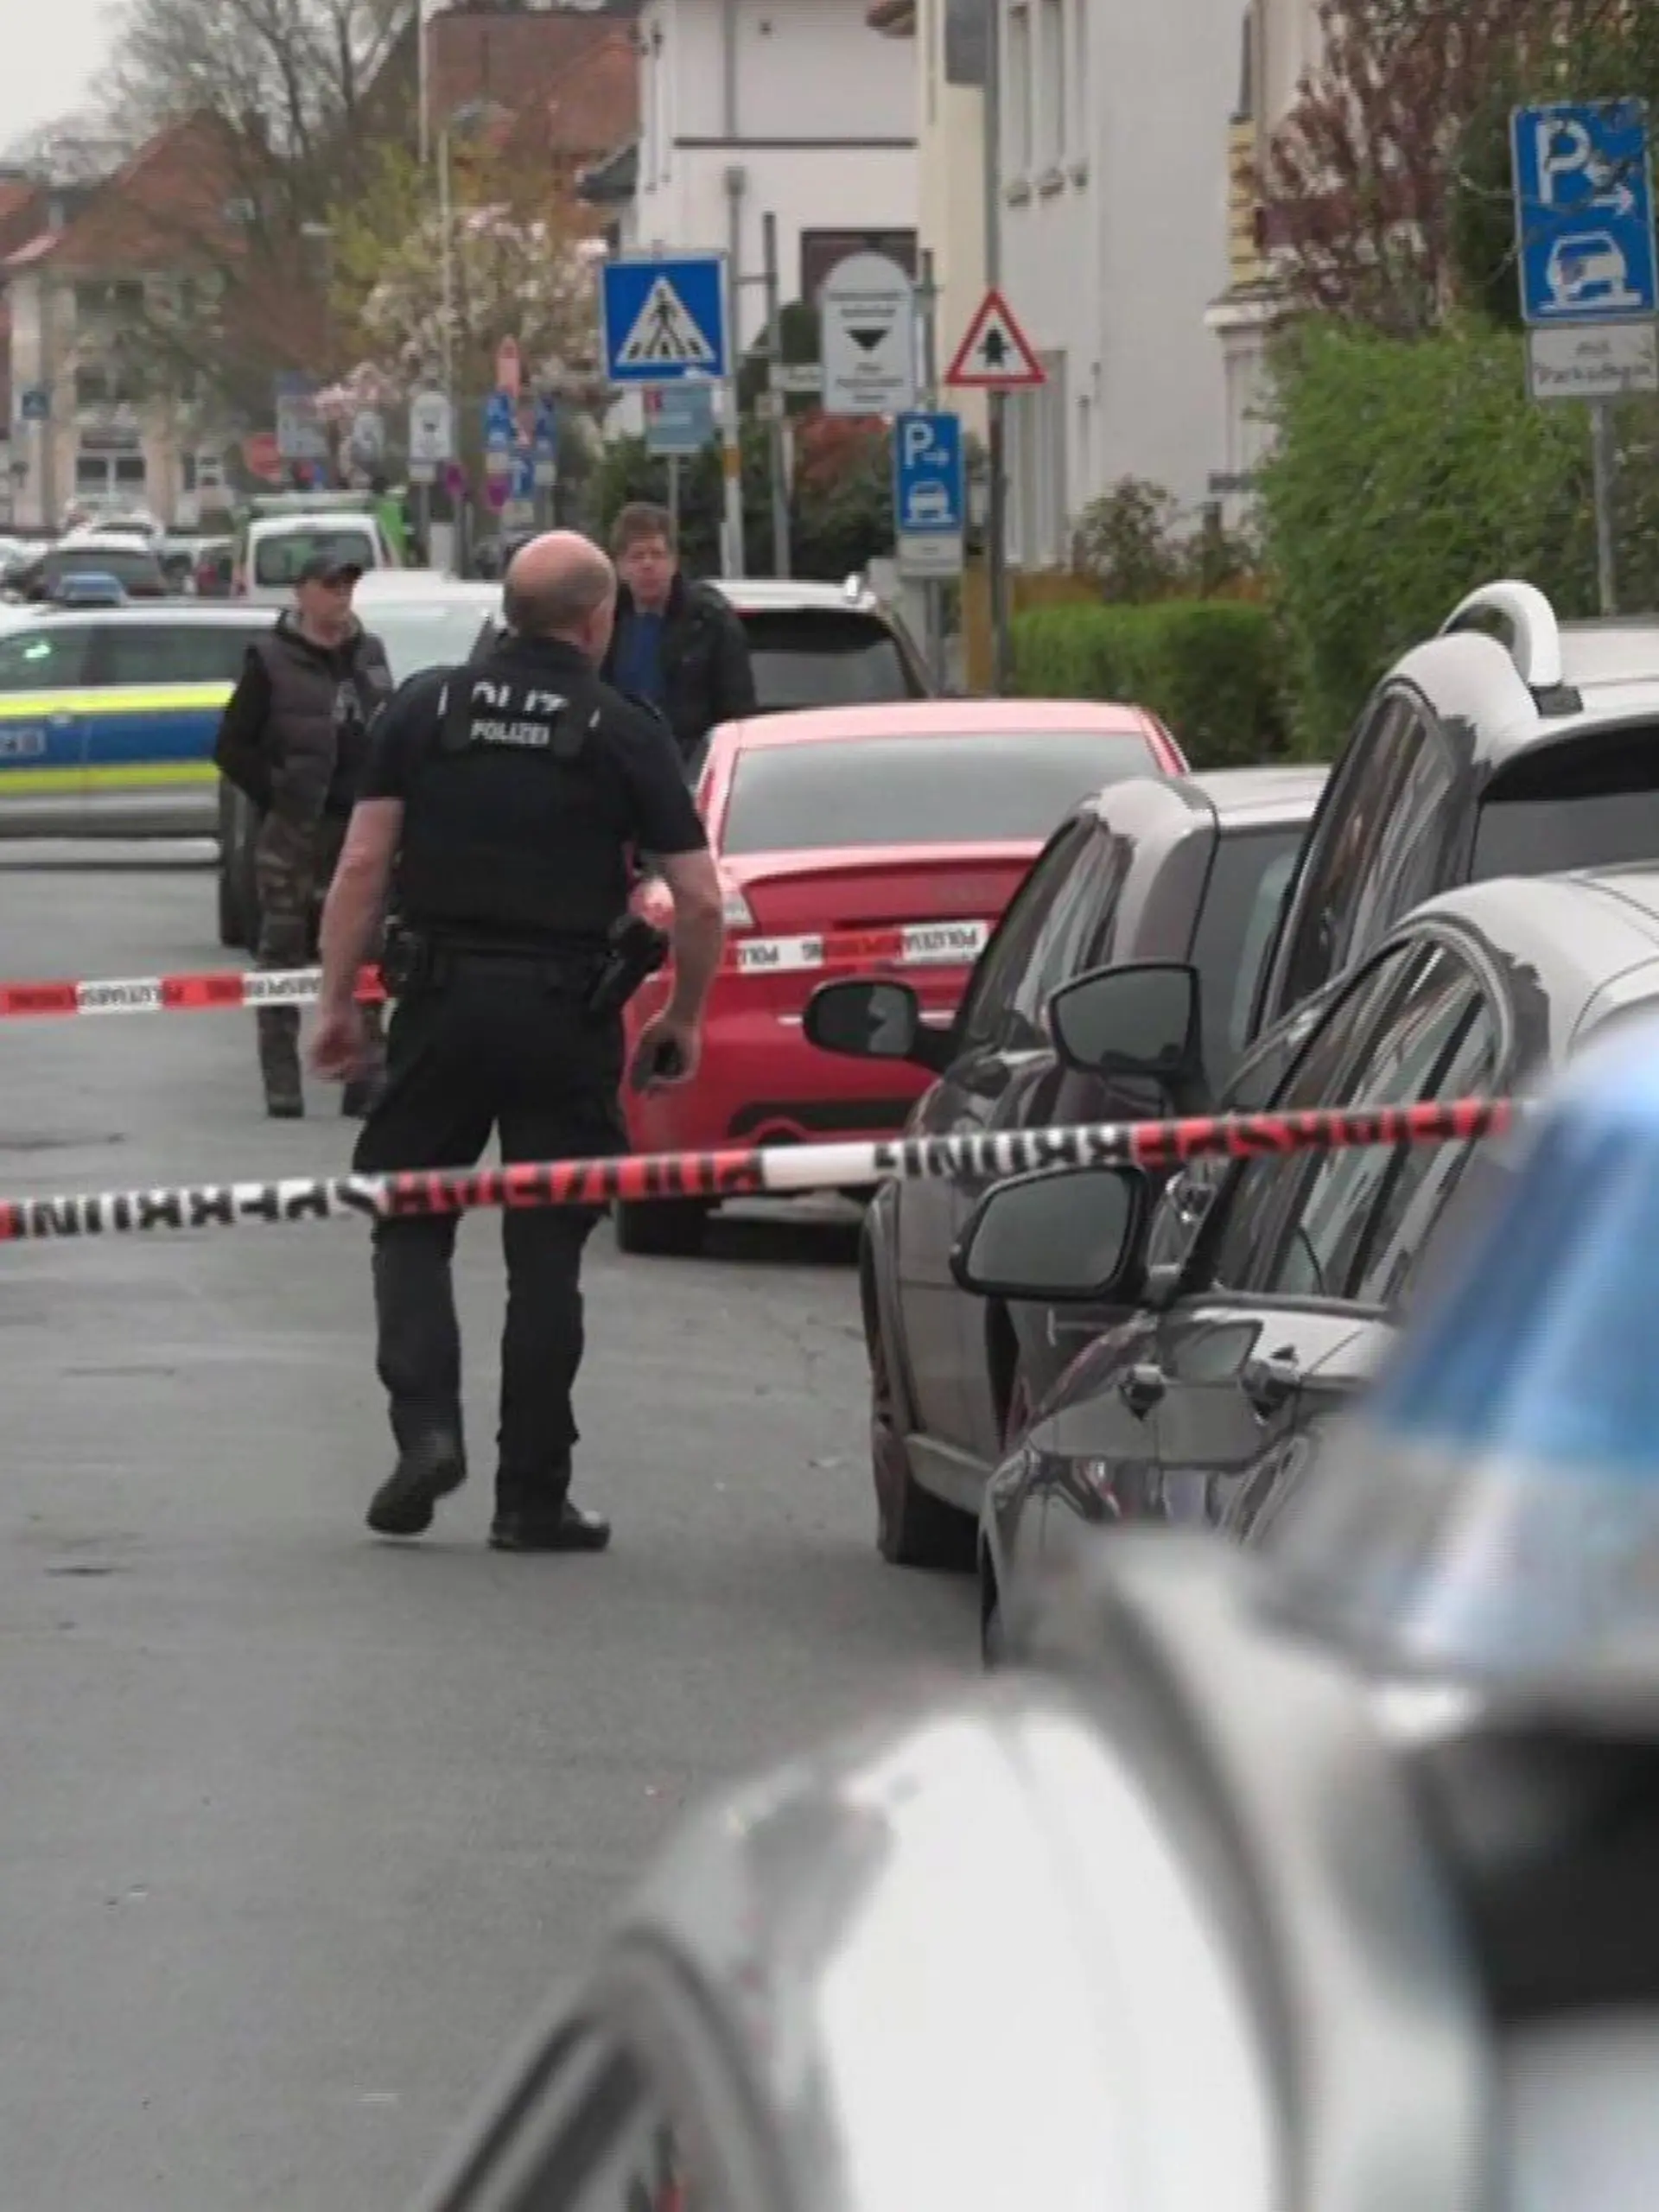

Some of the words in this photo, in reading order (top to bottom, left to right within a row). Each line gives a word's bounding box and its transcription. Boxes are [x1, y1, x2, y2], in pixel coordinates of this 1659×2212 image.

[1535, 119, 1590, 204] P
[904, 422, 935, 468] P
[469, 721, 550, 746] POLIZEI
